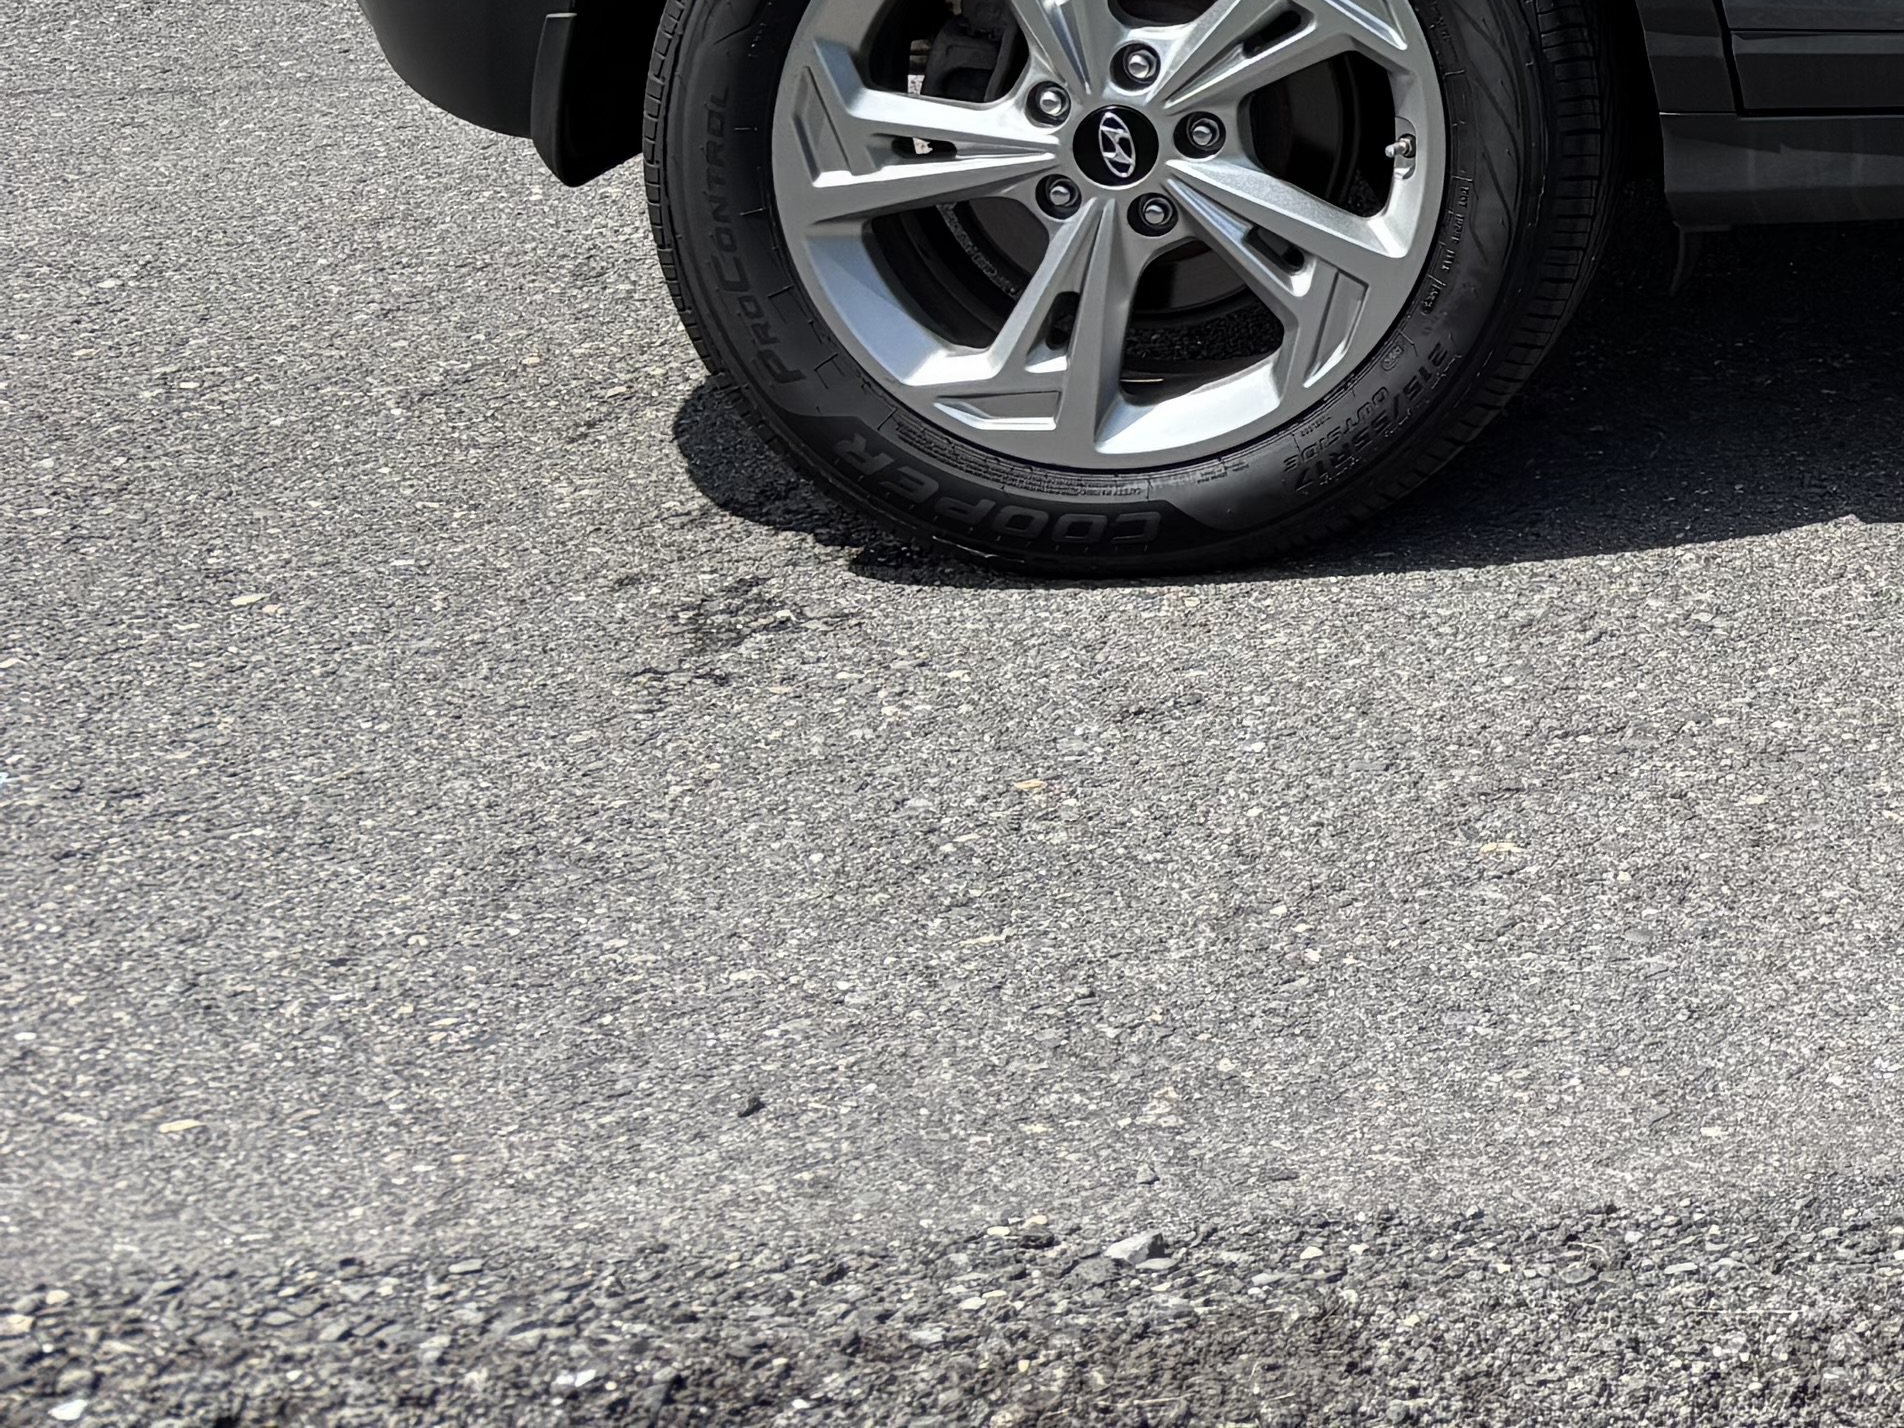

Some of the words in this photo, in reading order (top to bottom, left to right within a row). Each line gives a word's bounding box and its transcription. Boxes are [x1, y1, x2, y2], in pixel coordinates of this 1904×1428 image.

[1283, 386, 1389, 472] OUTSIDE
[1296, 342, 1449, 491] 215/55R17
[832, 429, 1164, 548] COOPER
